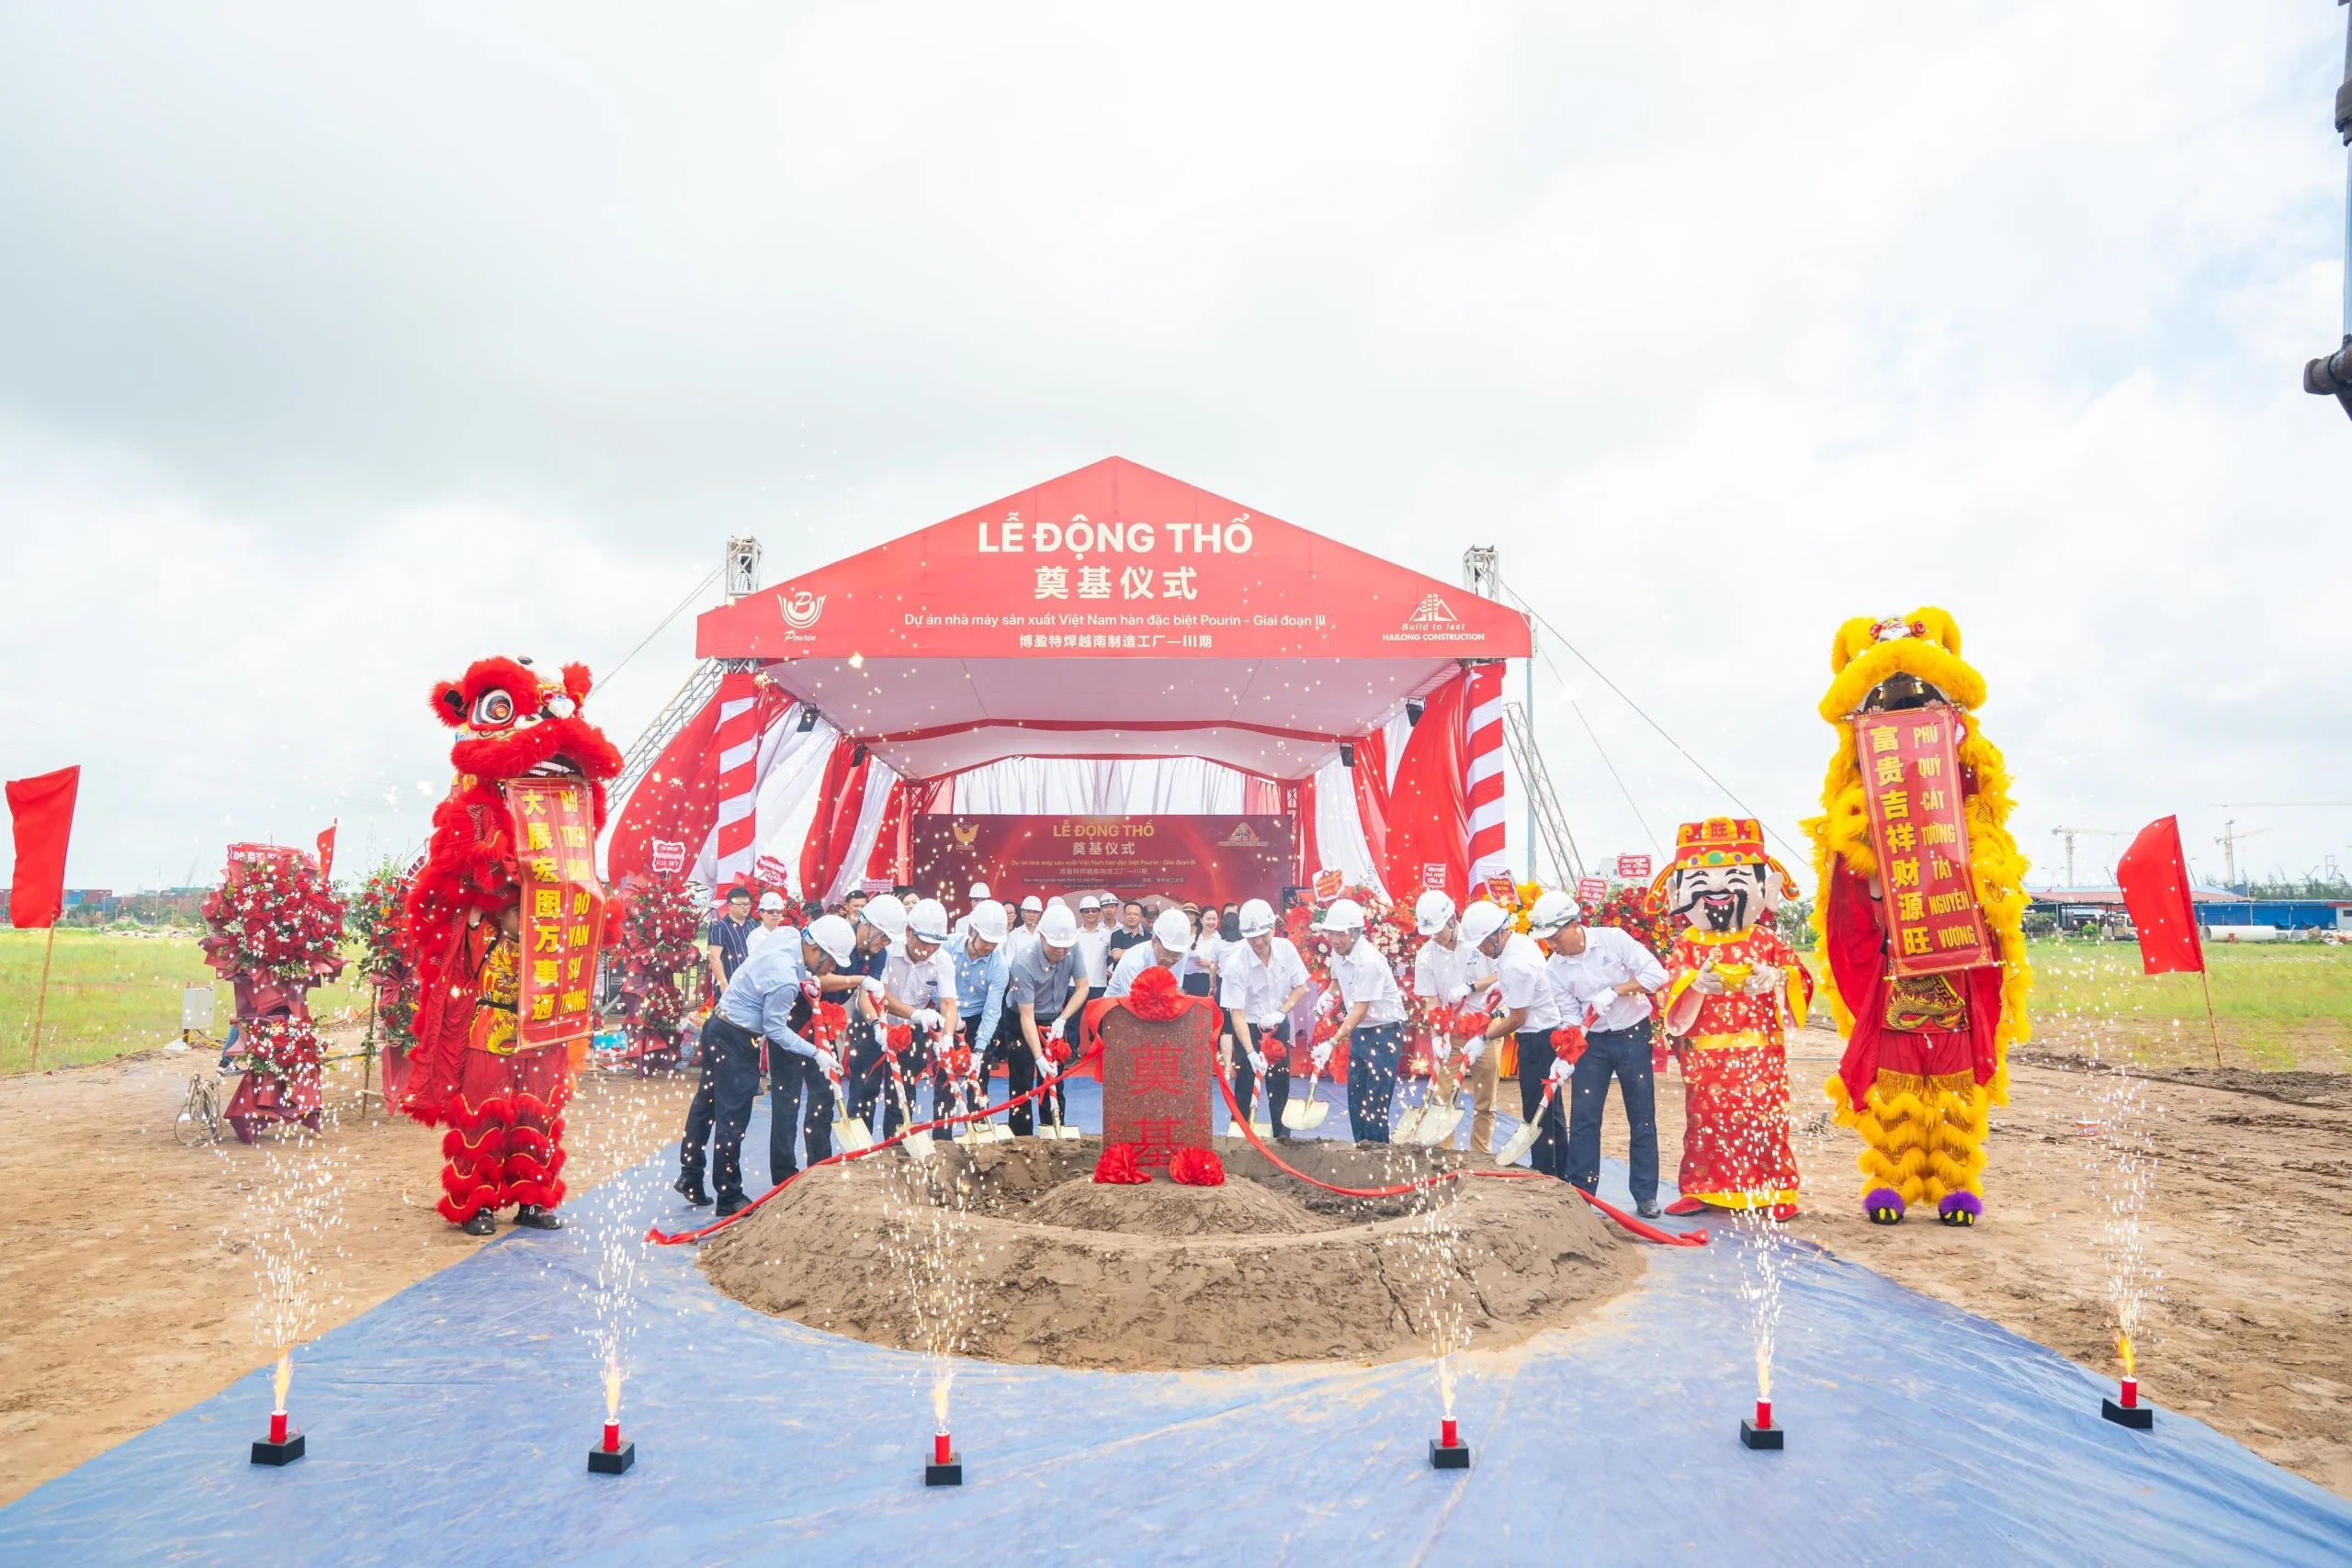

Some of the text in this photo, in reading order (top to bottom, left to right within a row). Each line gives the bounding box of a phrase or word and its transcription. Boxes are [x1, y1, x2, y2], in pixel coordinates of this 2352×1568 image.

[978, 512, 1253, 561] LỄ ĐỘNG THỔ
[1035, 566, 1198, 601] 奠基仪式
[904, 614, 923, 628] Dự
[926, 614, 942, 626] án
[944, 614, 969, 626] nhà
[971, 614, 998, 628] máy
[1001, 614, 1024, 626] sản
[1028, 613, 1056, 626] xuất
[1058, 614, 1085, 628] Việt
[1087, 614, 1117, 626] Nam
[1120, 614, 1144, 626] hàn
[1147, 614, 1171, 628] đặc
[1173, 615, 1198, 628] biệt
[1200, 615, 1241, 626] Pourin
[1253, 615, 1278, 626] Giai
[1281, 615, 1312, 628] đoạn
[1401, 623, 1465, 631] Build to last
[1382, 633, 1486, 641] HAILONG CONSTRUCTION
[1913, 722, 1939, 744] PHÚ
[1917, 753, 1941, 778] QUÝ
[1922, 786, 1945, 811] CÁT
[1053, 819, 1155, 840] LỄ ĐỘNG THỔ
[1870, 725, 1934, 956] 富贵吉祥财源旺
[1072, 841, 1136, 855] 奠基仪式
[1931, 855, 1953, 881] TÀI
[1928, 887, 1971, 915] NGUYÊN
[1937, 924, 1976, 950] VƯỢNG
[1127, 1042, 1185, 1168] 奠基
